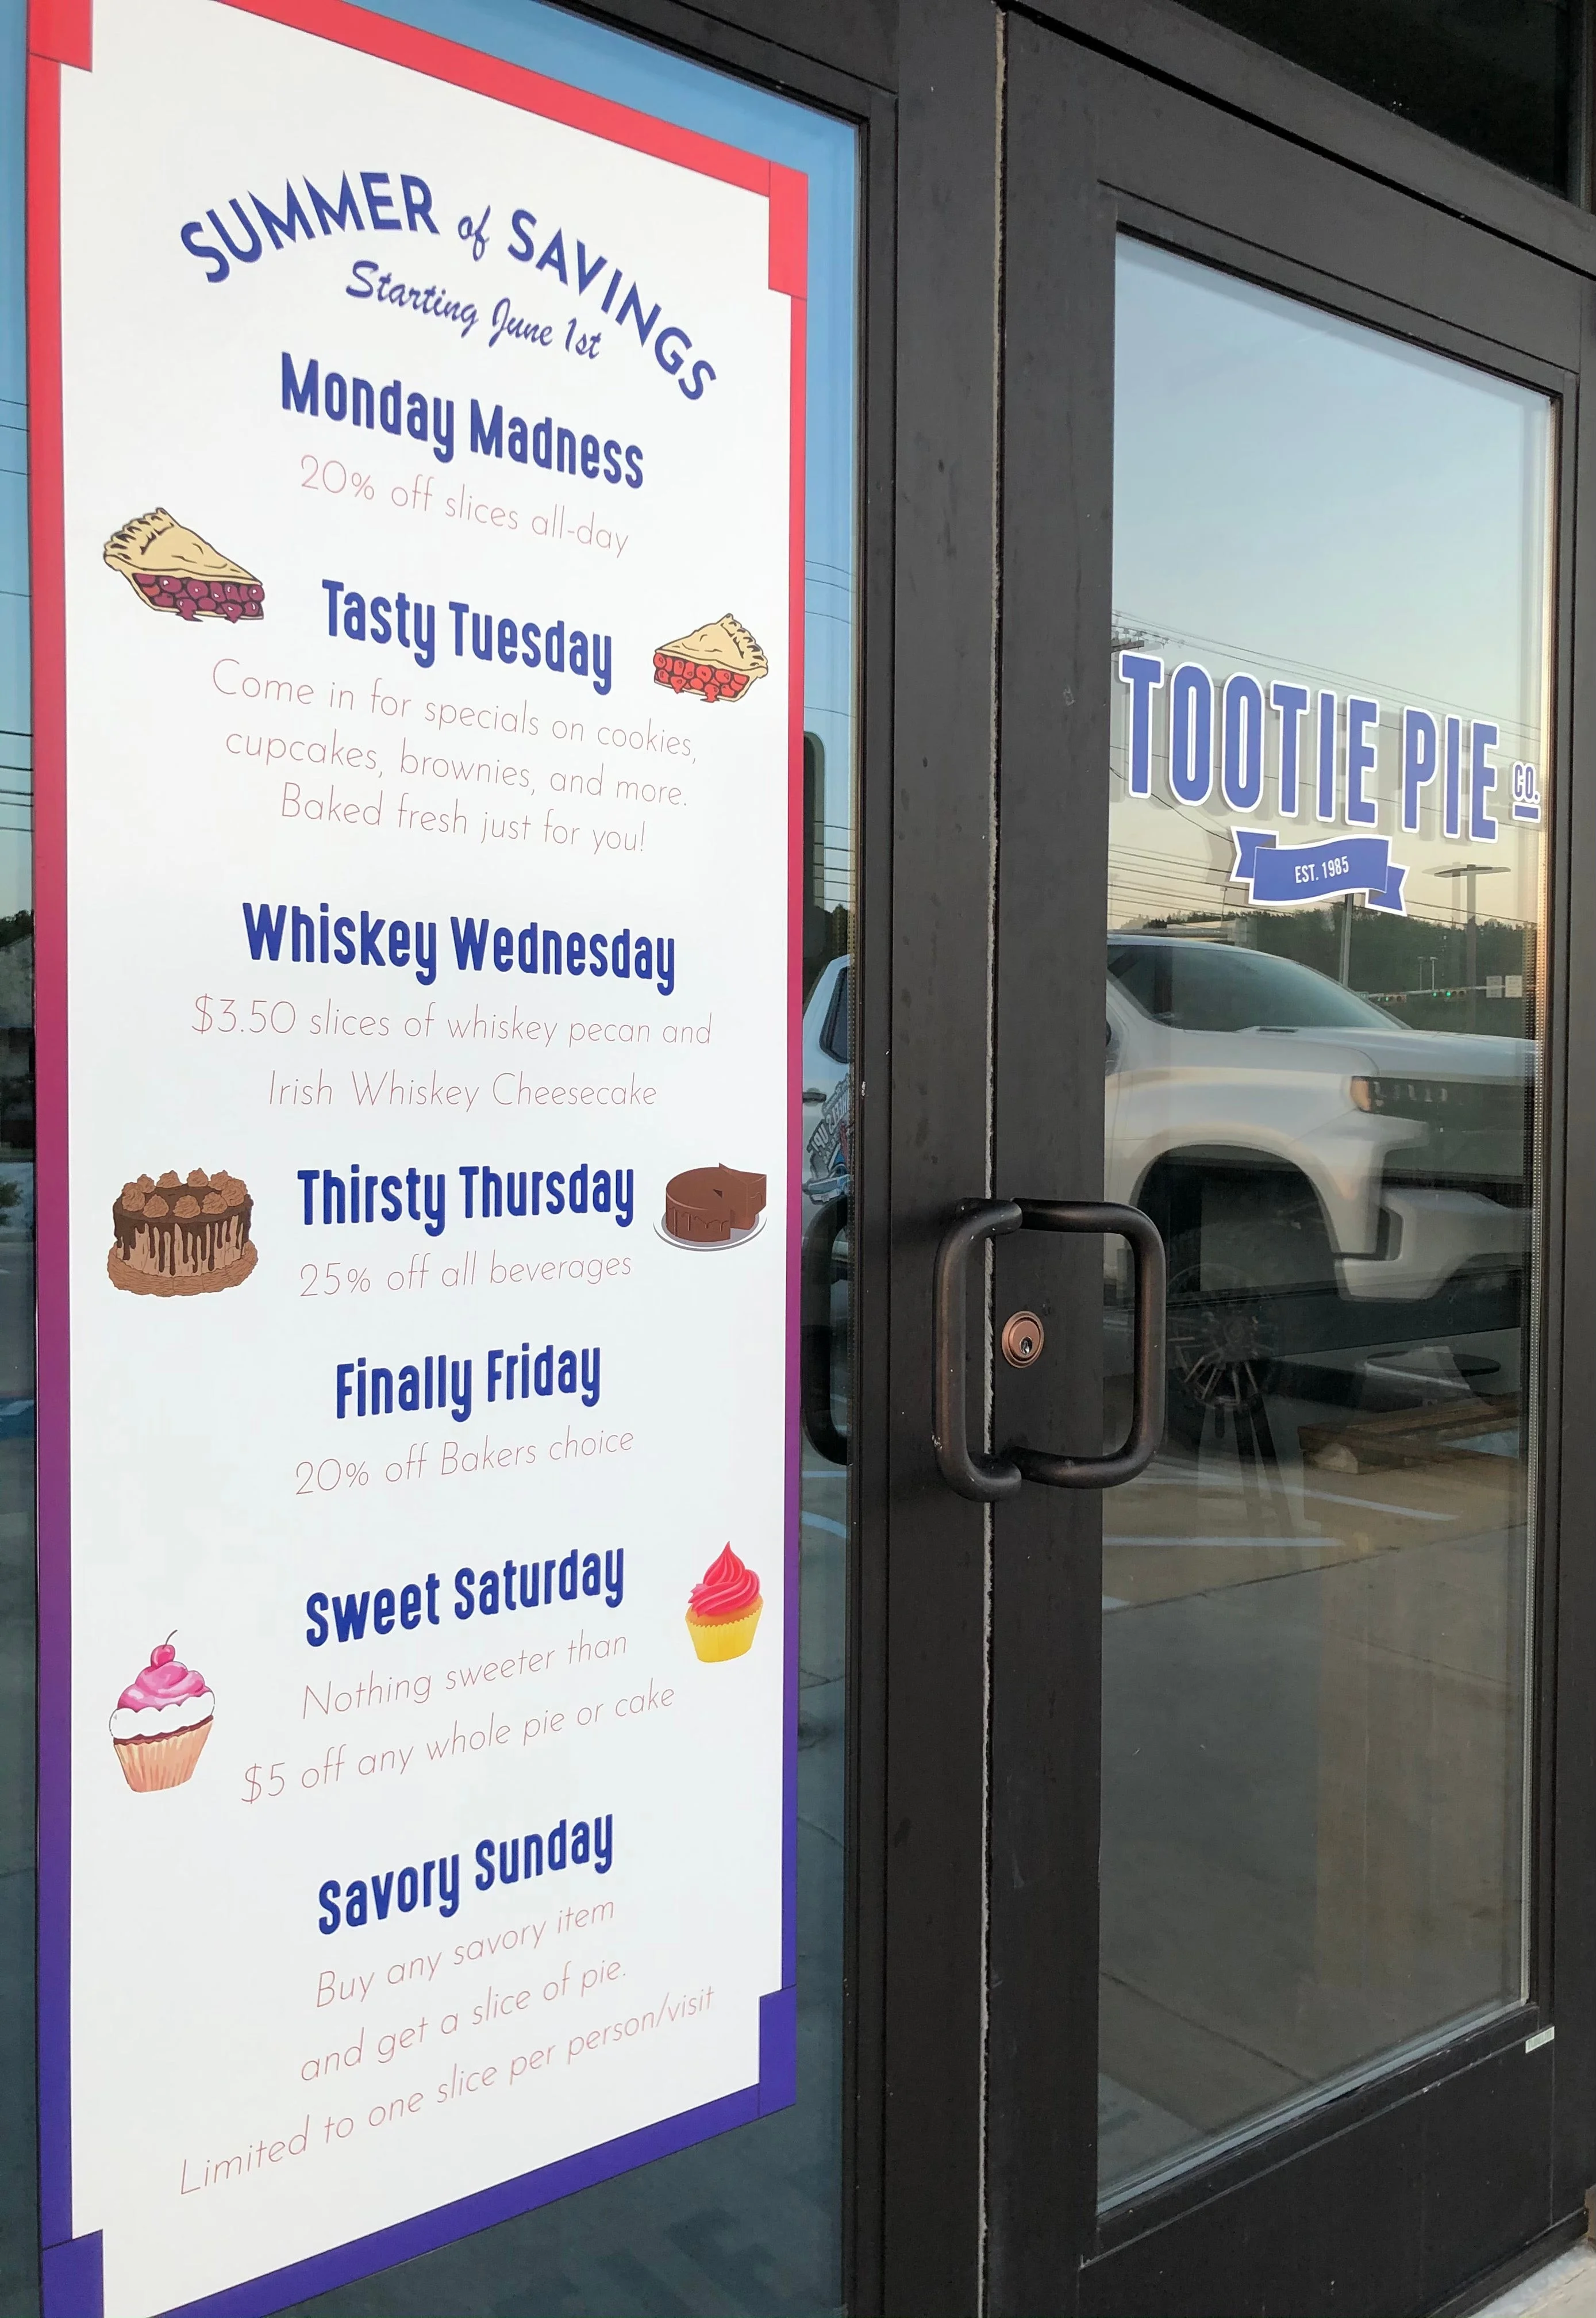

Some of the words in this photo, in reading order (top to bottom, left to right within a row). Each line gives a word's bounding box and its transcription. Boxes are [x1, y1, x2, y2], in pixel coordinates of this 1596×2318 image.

[179, 170, 441, 286] SUMMER
[457, 204, 491, 262] of
[506, 208, 717, 401] SAVINGS
[345, 258, 479, 339] Starting
[488, 297, 553, 348] June
[565, 317, 602, 360] 1st
[280, 350, 454, 464] Monday
[469, 398, 643, 490] Madness
[301, 454, 374, 500] 20%
[391, 474, 434, 511] off
[445, 483, 518, 529] slices
[532, 504, 628, 558] all-day
[322, 578, 435, 669] Tasty
[448, 600, 612, 696] Tuesday
[213, 658, 314, 704] Come
[330, 682, 353, 711] in
[371, 678, 412, 717] for
[425, 700, 538, 735] specials
[552, 720, 584, 742] on
[598, 717, 695, 764] cookies,
[1118, 650, 1380, 828] TOOTIE
[1401, 705, 1500, 844] PIE
[1513, 761, 1540, 804] CO.
[226, 728, 382, 778] cupcakes,
[399, 738, 536, 796] brownies,
[551, 762, 603, 796] and
[617, 781, 686, 806] more.
[282, 782, 383, 826] Baked
[398, 793, 467, 834] fresh
[481, 812, 531, 843] just
[544, 809, 580, 845] for
[593, 820, 645, 855] you!
[1295, 864, 1319, 883] EST.
[1322, 855, 1349, 878] 1985
[242, 901, 437, 987] Whiskey
[450, 915, 675, 997] Wednesday
[191, 993, 299, 1036] $3.50
[308, 998, 391, 1037] slices
[405, 1001, 436, 1039] of
[446, 1003, 559, 1047] whiskey
[569, 1021, 649, 1048] pecan
[663, 1012, 712, 1044] and
[270, 1068, 333, 1106] Irish
[351, 1068, 482, 1112] Whiskey
[492, 1070, 656, 1108] Cheesecake
[297, 1164, 446, 1238] Thirsty
[456, 1163, 634, 1228] Thursday
[299, 1260, 370, 1297] 25%
[386, 1251, 432, 1292] off
[441, 1250, 478, 1288] all
[490, 1249, 631, 1284] beverages
[336, 1352, 474, 1425] Finally
[485, 1341, 602, 1407] Friday
[294, 1458, 370, 1495] 20%
[384, 1440, 429, 1483] off
[441, 1435, 536, 1475] Bakers
[548, 1425, 634, 1463] choice
[305, 1572, 441, 1648] Sweet
[453, 1546, 625, 1621] Saturday
[303, 1670, 432, 1720] Nothing
[446, 1649, 555, 1690] sweeter
[567, 1628, 628, 1664] than
[241, 1761, 285, 1805] $5
[299, 1744, 347, 1789] off
[358, 1746, 414, 1775] any
[426, 1711, 510, 1761] whole
[524, 1709, 566, 1747] pie
[577, 1702, 605, 1727] or
[616, 1677, 676, 1717] cake
[317, 1853, 460, 1937] Savory
[474, 1812, 614, 1893] Sunday
[317, 1971, 375, 2008] Buy
[386, 1950, 444, 1986] any
[453, 1920, 547, 1966] savory
[557, 1902, 614, 1933] item
[300, 2027, 365, 2083] and
[377, 2017, 429, 2065] get
[440, 2013, 458, 2034] a
[471, 1986, 530, 2025] slice
[543, 1960, 571, 2001] of
[580, 1960, 625, 1997] pie.
[180, 2114, 310, 2196] Limited
[324, 2115, 355, 2144] to
[368, 2093, 424, 2127] one
[437, 2063, 497, 2104] slice
[509, 2045, 556, 2086] per
[566, 1986, 715, 2065] person/visit
